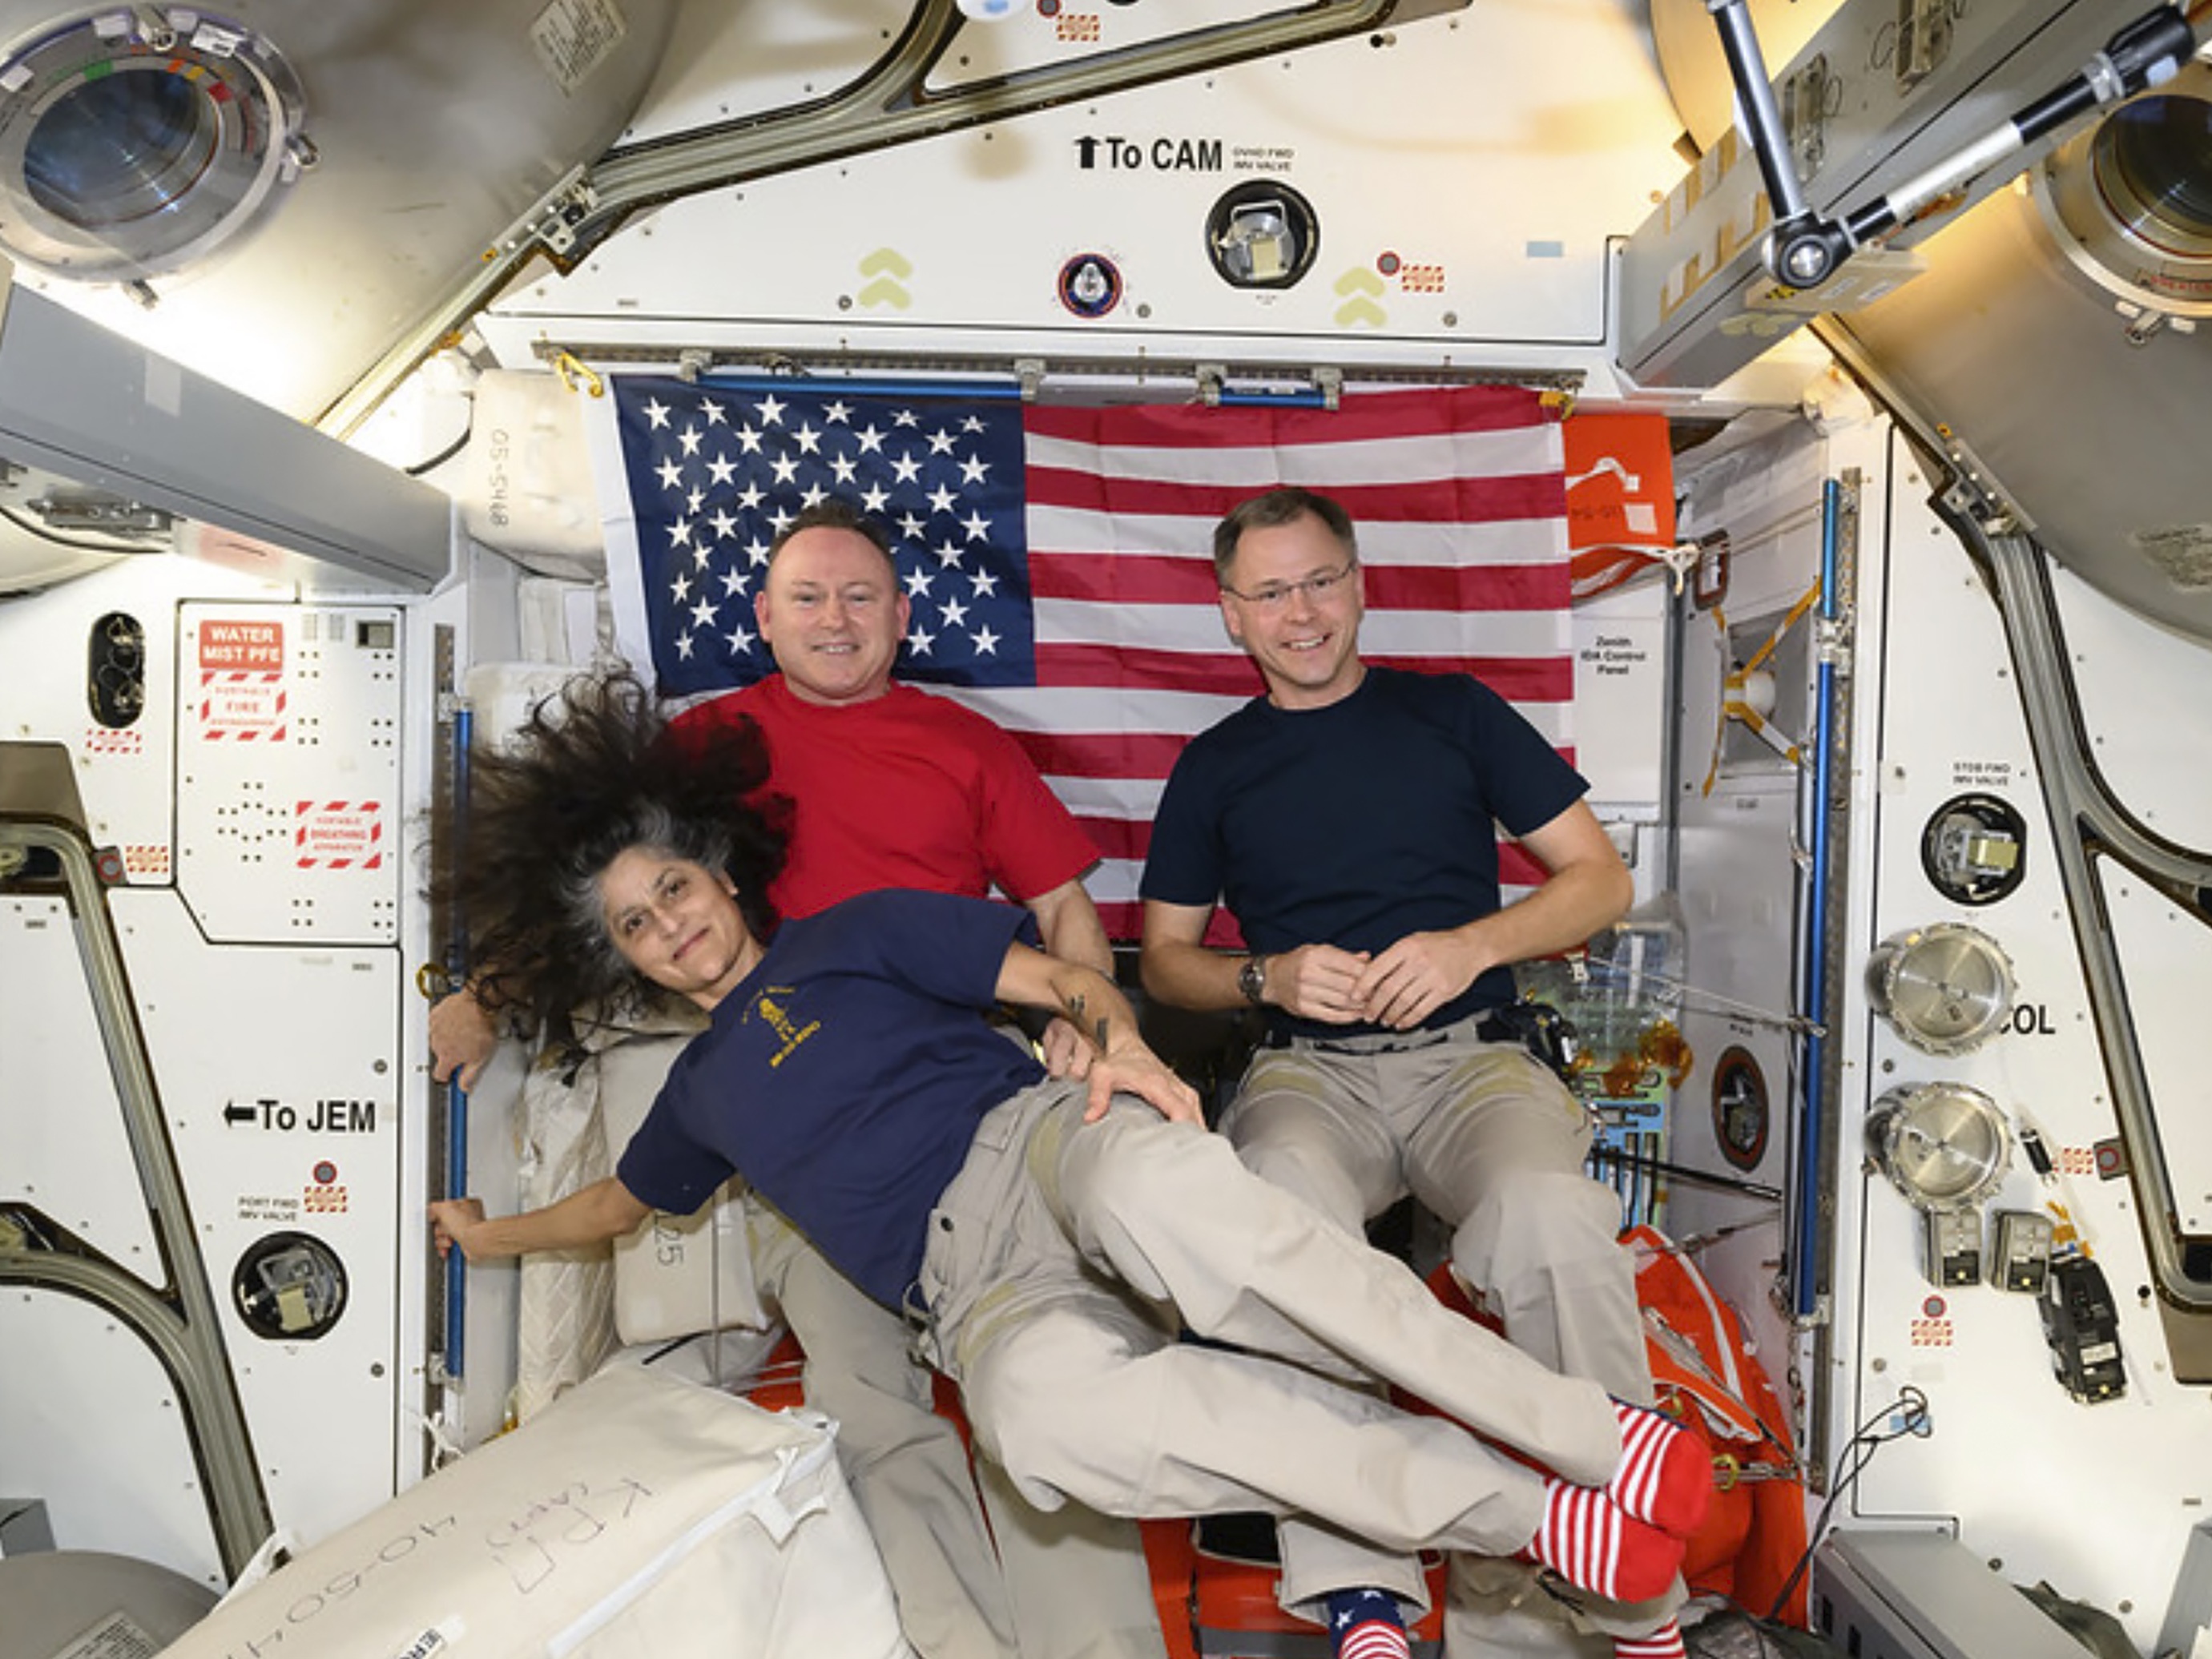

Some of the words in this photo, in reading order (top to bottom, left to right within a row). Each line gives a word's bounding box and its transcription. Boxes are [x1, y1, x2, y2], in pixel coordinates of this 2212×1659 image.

[1106, 137, 1142, 169] To
[1151, 138, 1223, 171] CAM
[1256, 161, 1291, 171] VALVE
[211, 626, 274, 642] WATER
[1596, 636, 1632, 646] Zenith
[203, 645, 244, 662] MIST
[249, 646, 280, 662] PFE
[1603, 650, 1646, 661] Control
[1597, 665, 1630, 674] Panel
[1976, 775, 2008, 786] VALVE
[311, 829, 367, 840] BREATHING
[2000, 1004, 2056, 1035] OL
[256, 1099, 296, 1130] To
[307, 1100, 376, 1133] JEM
[262, 1211, 296, 1222] VALVE
